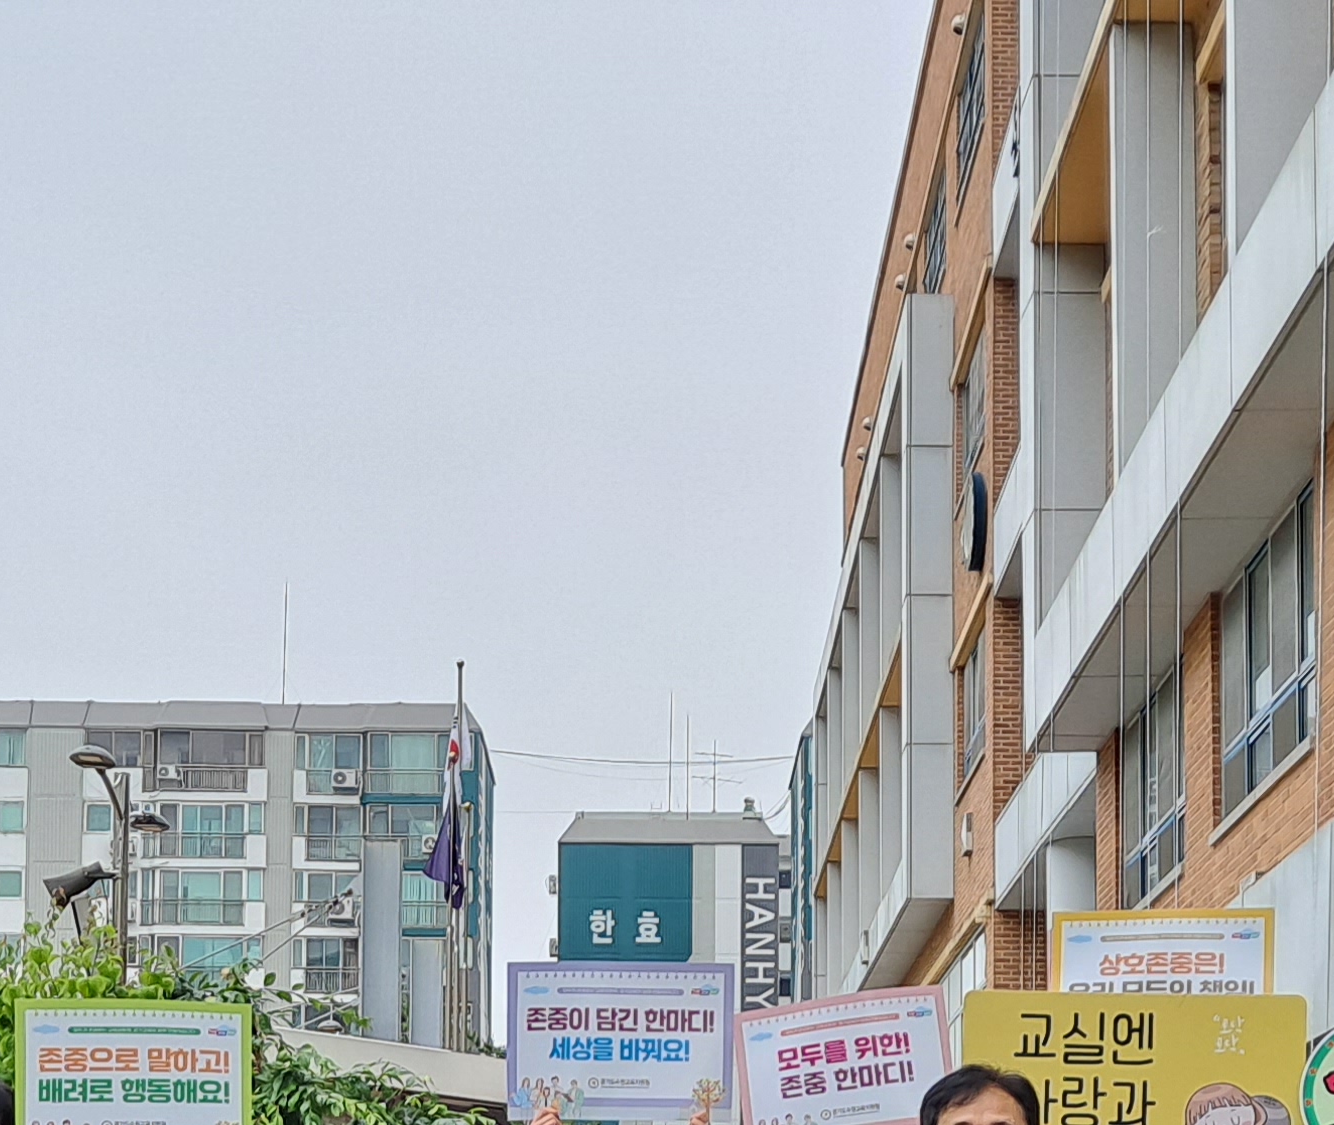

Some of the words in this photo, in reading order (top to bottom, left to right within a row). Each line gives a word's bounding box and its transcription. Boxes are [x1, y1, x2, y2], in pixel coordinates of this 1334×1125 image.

[745, 877, 776, 1009] HANHY
[1099, 951, 1225, 977] 상호존중은!
[526, 1007, 590, 1032] 존중이
[595, 1007, 639, 1032] 담긴
[644, 1008, 715, 1033] 한마디!
[549, 1037, 614, 1061] 세상을
[619, 1038, 691, 1062] 바꿔요!
[777, 1039, 848, 1071] 모두를
[854, 1031, 910, 1058] 위한!
[1013, 1011, 1155, 1067] 교실엔
[38, 1047, 140, 1073] 존중으로
[146, 1047, 230, 1074] 말하고!
[38, 1079, 114, 1104] 배려로
[120, 1079, 230, 1104] 행동해요!
[779, 1072, 827, 1099] 존중
[834, 1060, 914, 1088] 한마디!
